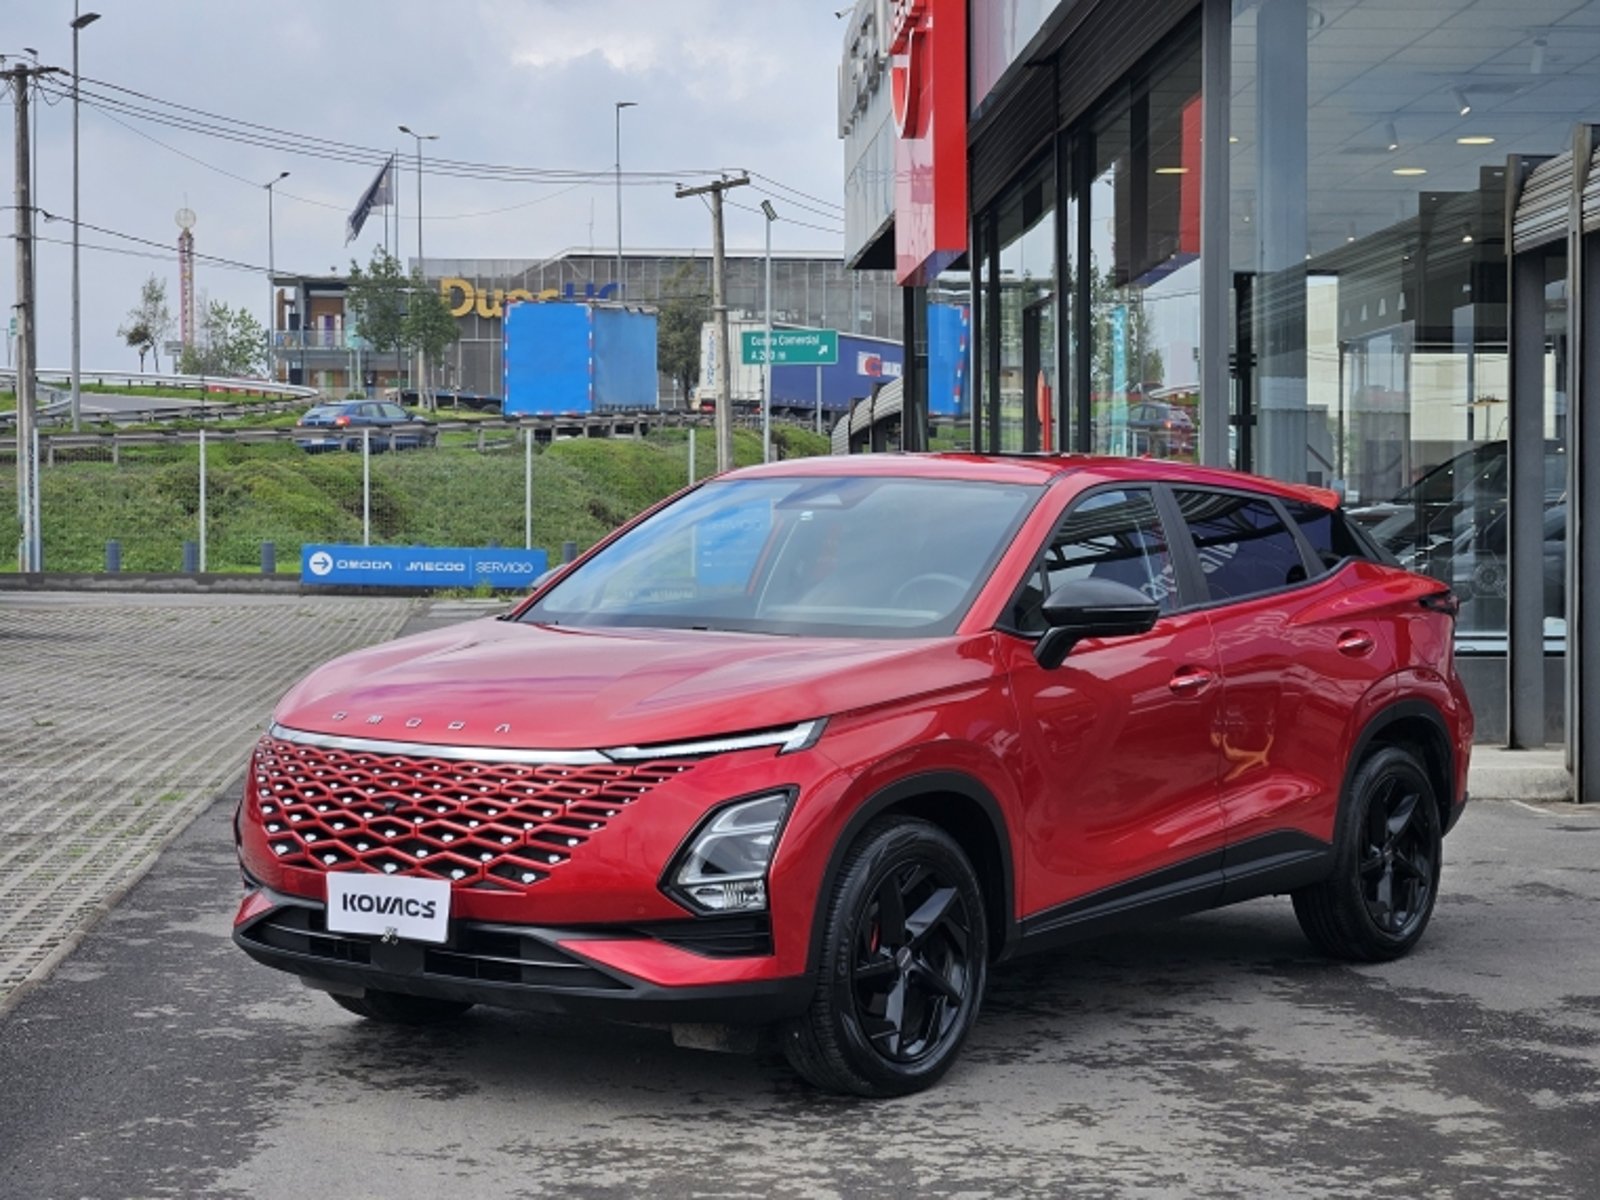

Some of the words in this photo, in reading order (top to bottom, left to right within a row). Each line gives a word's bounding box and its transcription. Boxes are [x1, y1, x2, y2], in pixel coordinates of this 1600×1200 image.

[336, 560, 392, 570] OMODA
[405, 561, 465, 572] JAECOO
[475, 561, 534, 574] SERVICIO
[332, 711, 511, 733] OMODA
[342, 892, 436, 919] KOVACS
